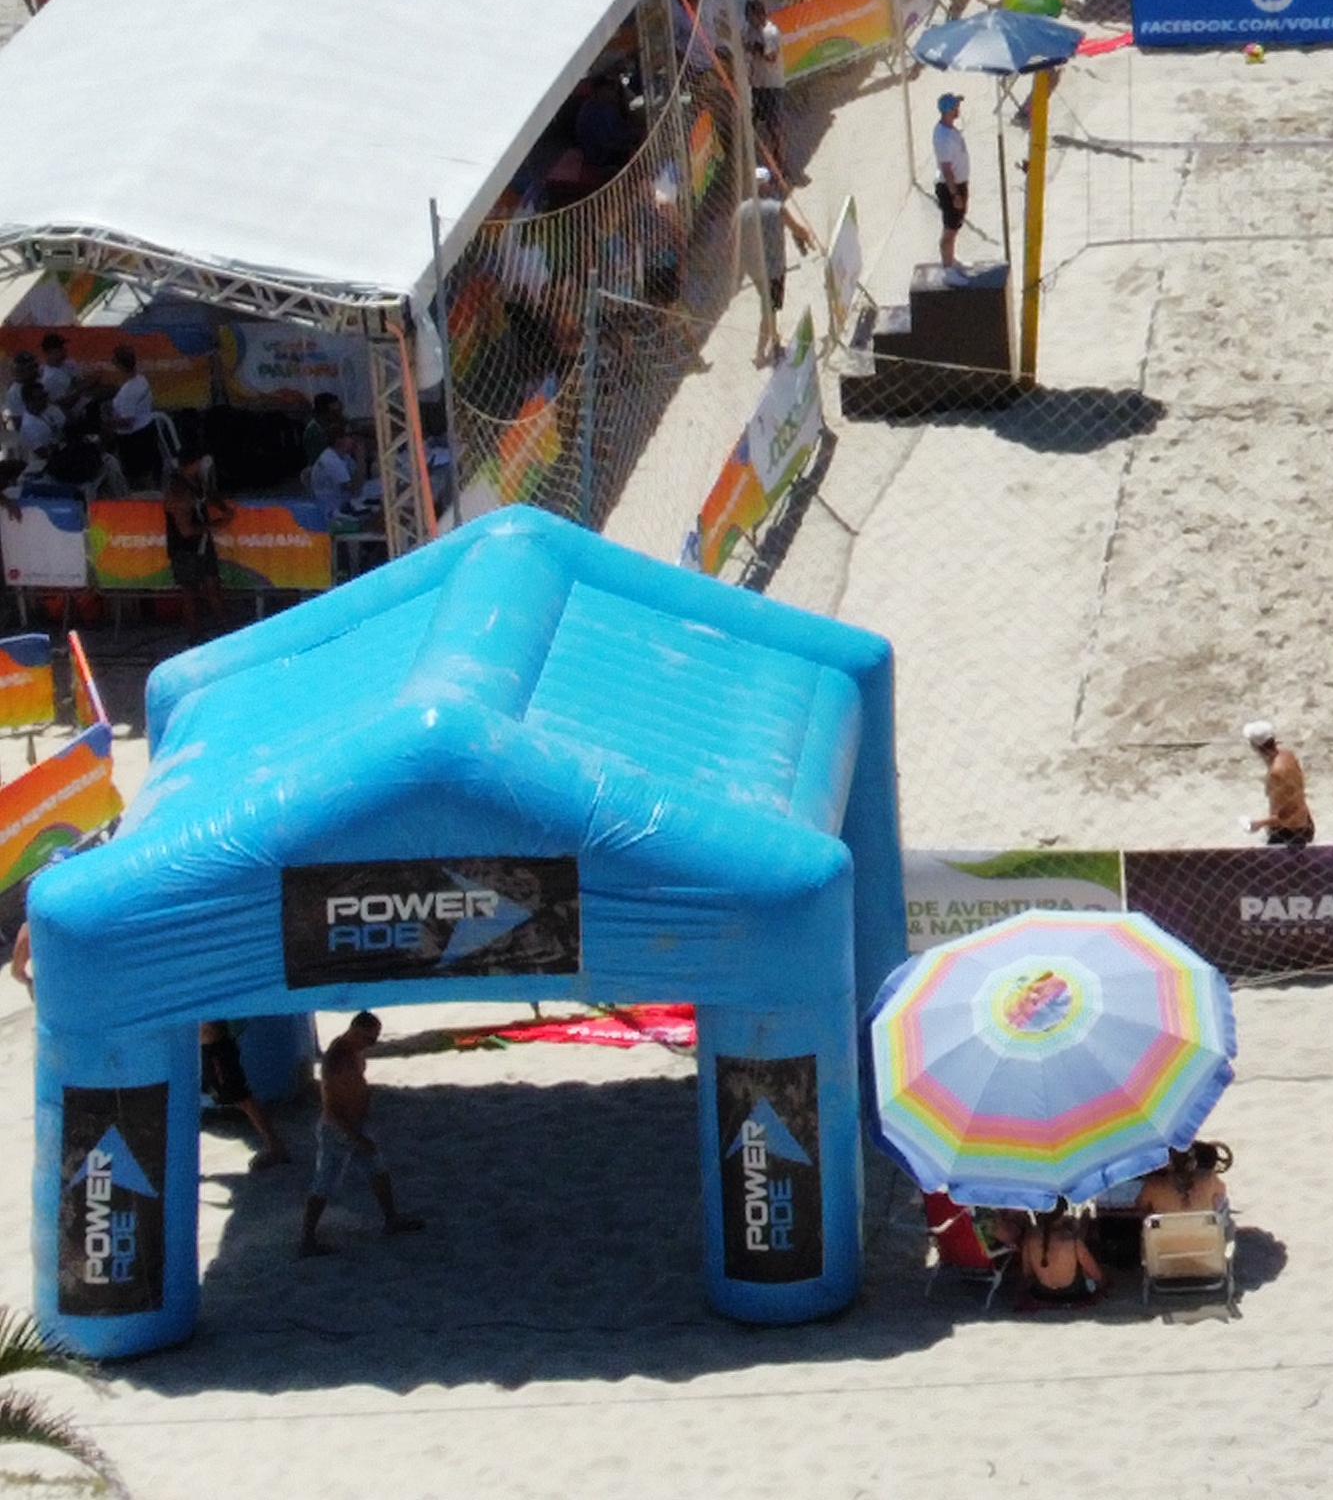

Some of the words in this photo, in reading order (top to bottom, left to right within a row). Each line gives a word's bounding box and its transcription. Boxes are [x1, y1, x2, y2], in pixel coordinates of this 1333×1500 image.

[326, 889, 499, 925] POWER
[908, 901, 939, 917] DE
[908, 920, 924, 935] &
[741, 1119, 770, 1252] POWER
[84, 1147, 114, 1285] POWER
